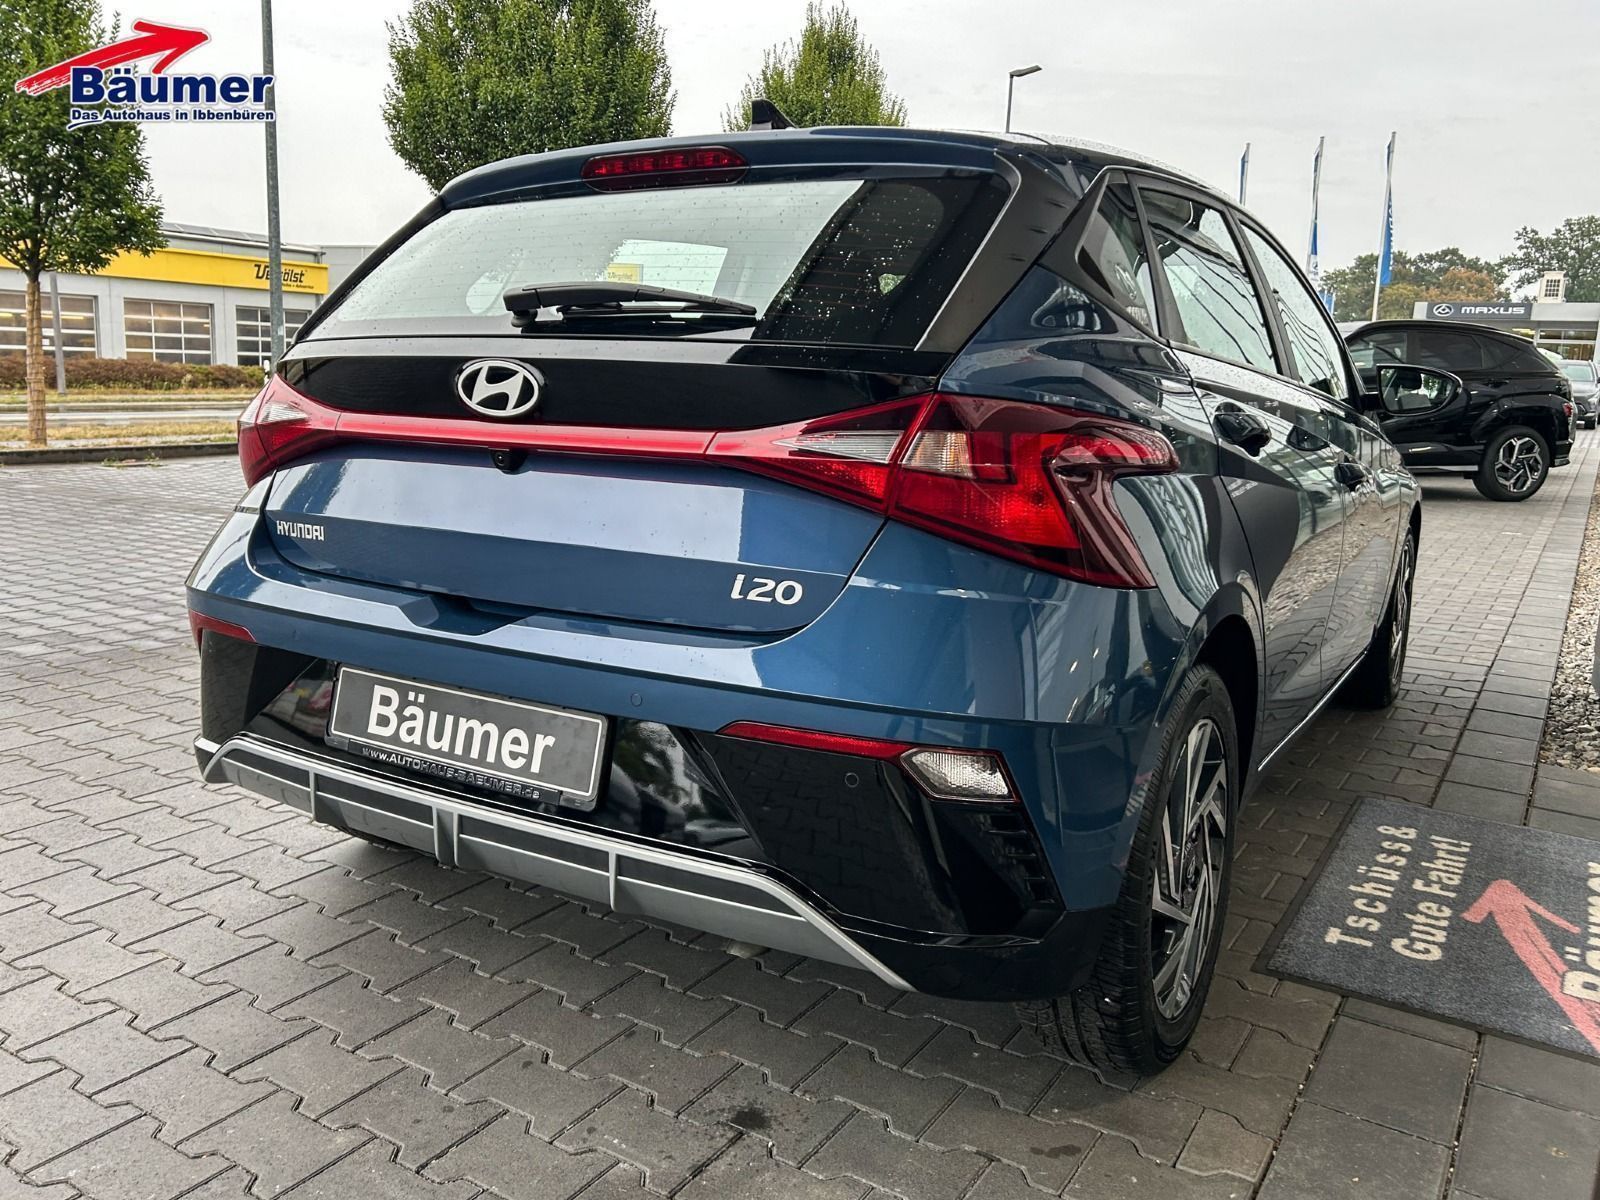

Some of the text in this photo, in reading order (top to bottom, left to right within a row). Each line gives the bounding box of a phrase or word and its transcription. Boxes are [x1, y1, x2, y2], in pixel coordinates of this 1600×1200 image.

[276, 520, 325, 541] HYUNDAI
[730, 573, 803, 605] i20
[367, 684, 556, 774] Bäumer
[1391, 835, 1472, 961] Gute Fahrt!
